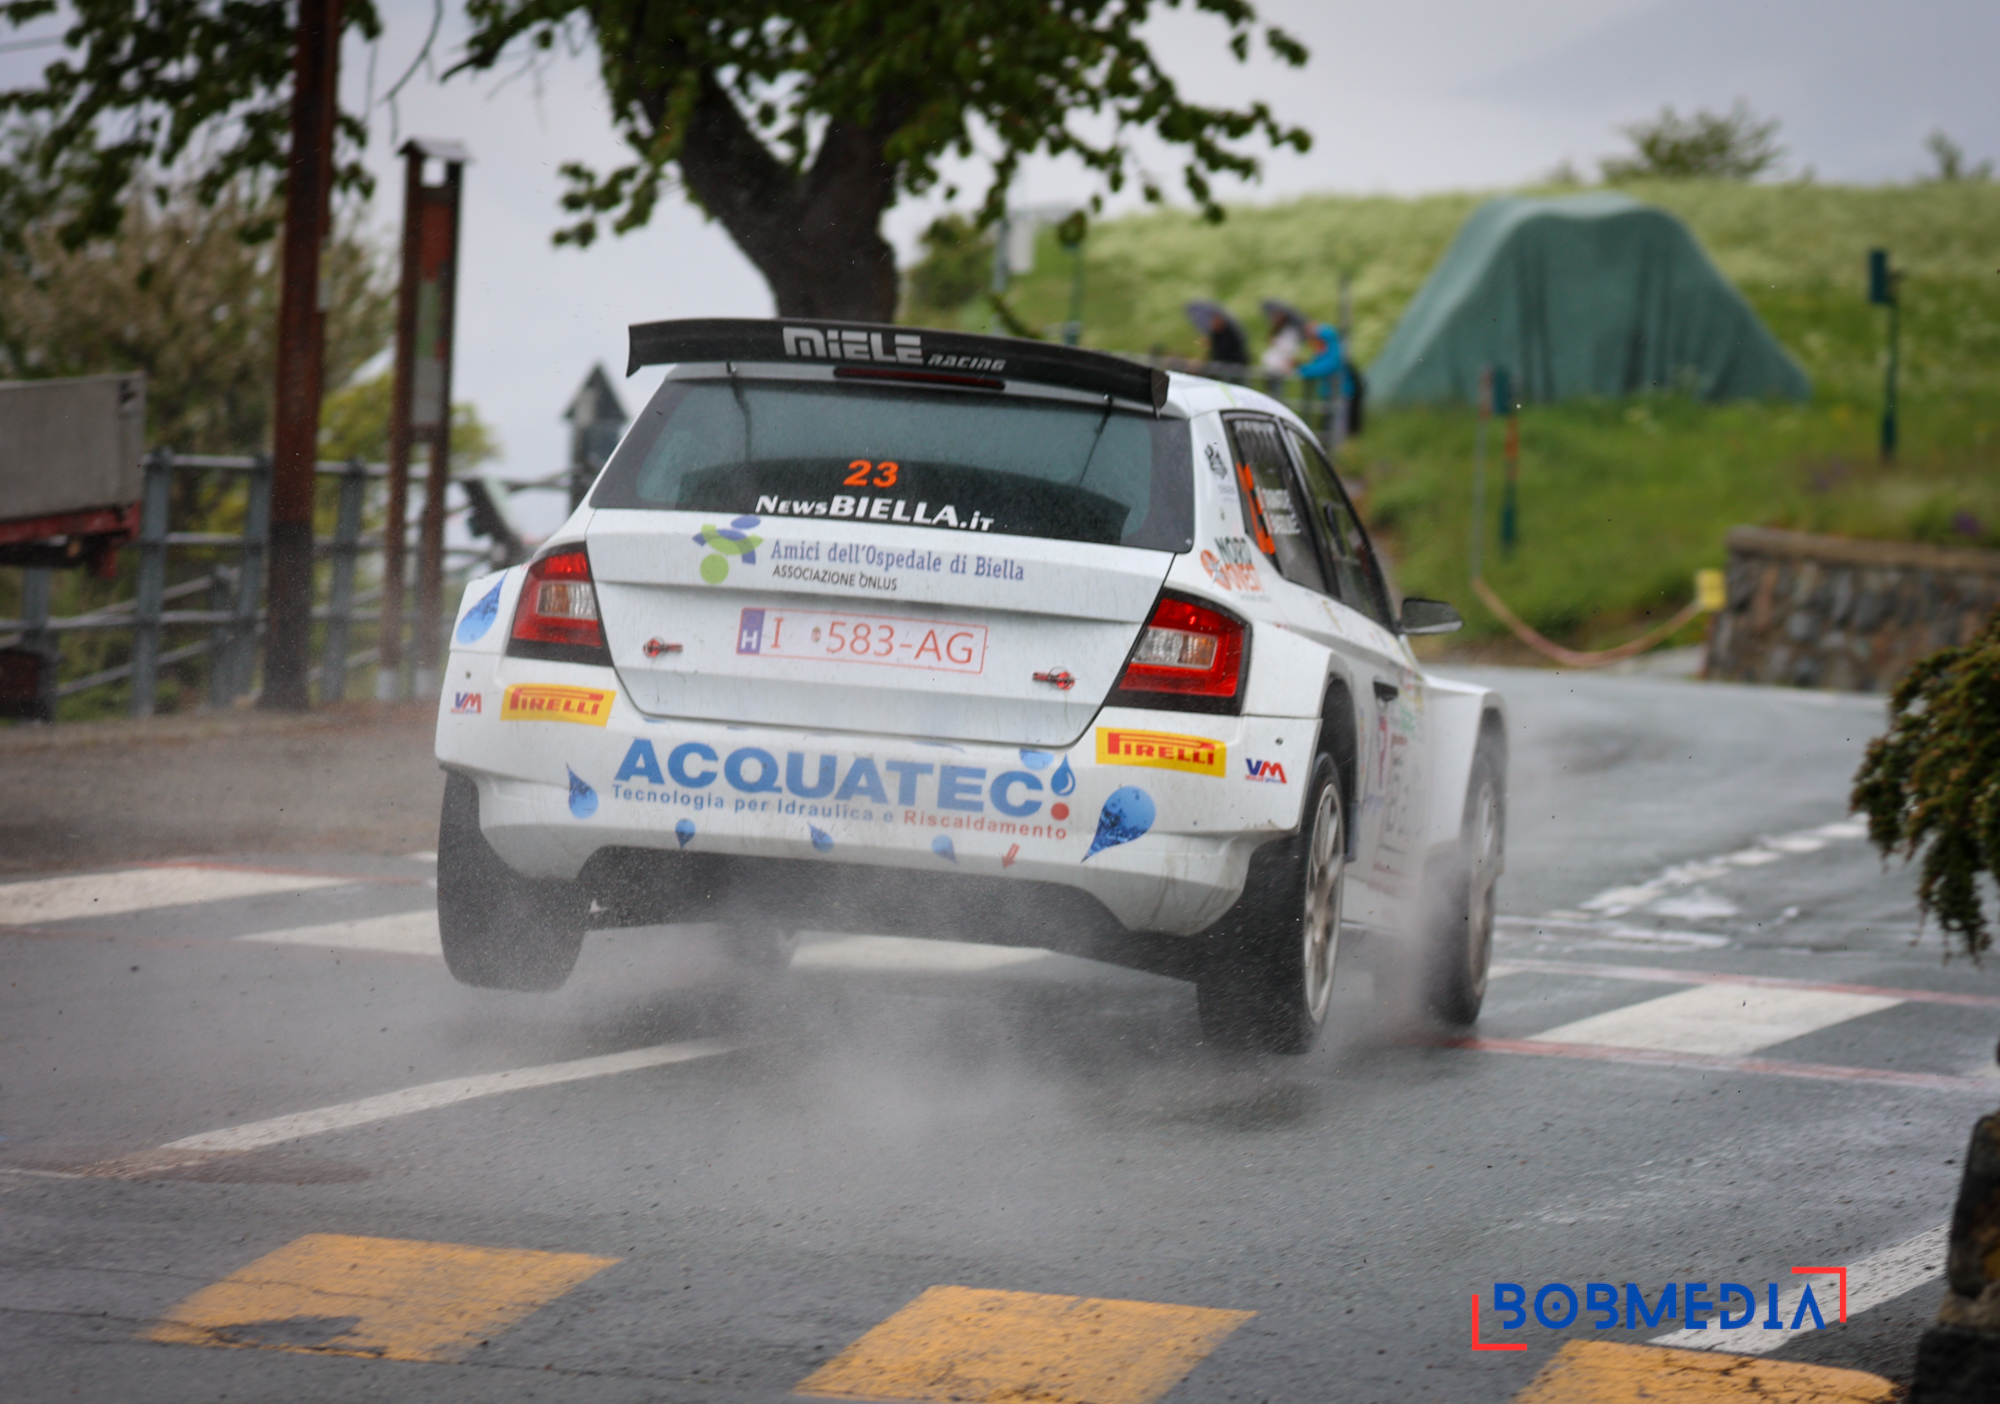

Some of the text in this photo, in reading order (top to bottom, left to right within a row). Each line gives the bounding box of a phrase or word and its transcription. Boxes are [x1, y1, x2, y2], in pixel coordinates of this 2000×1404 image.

[927, 354, 1007, 372] RACING
[843, 459, 899, 488] 23
[771, 540, 1025, 581] Amici dell'Ospedale di Biella
[772, 565, 898, 591] ASSOCIAZIONE ONLUS
[740, 617, 974, 664] H I 583-AG
[455, 692, 482, 714] VM
[509, 687, 604, 716] PIRELLI
[1107, 732, 1216, 766] PIRELLI
[1245, 757, 1288, 784] VM
[612, 784, 1067, 840] Tecnologia per Idraulica e Riscaldamento
